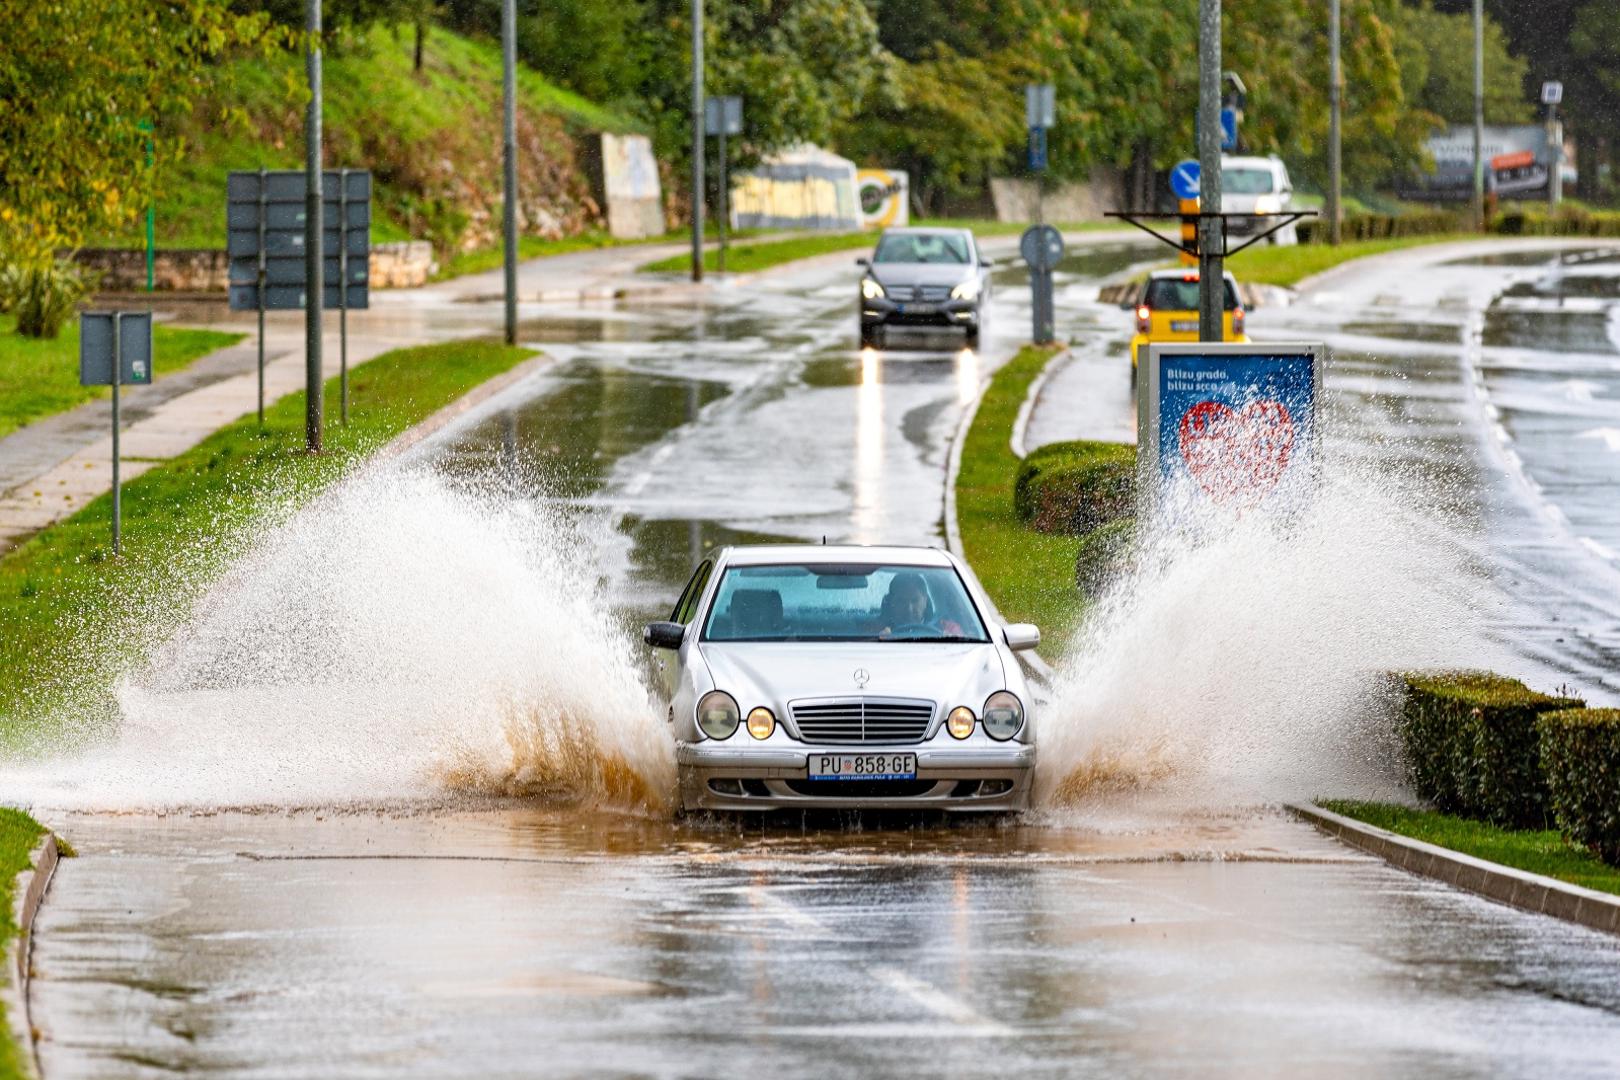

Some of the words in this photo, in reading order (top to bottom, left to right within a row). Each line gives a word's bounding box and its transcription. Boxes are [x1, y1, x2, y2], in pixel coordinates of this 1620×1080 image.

[1167, 368, 1194, 379] Blizu
[1167, 380, 1194, 391] blizu
[820, 757, 841, 774] PU
[854, 756, 913, 774] 858-GE
